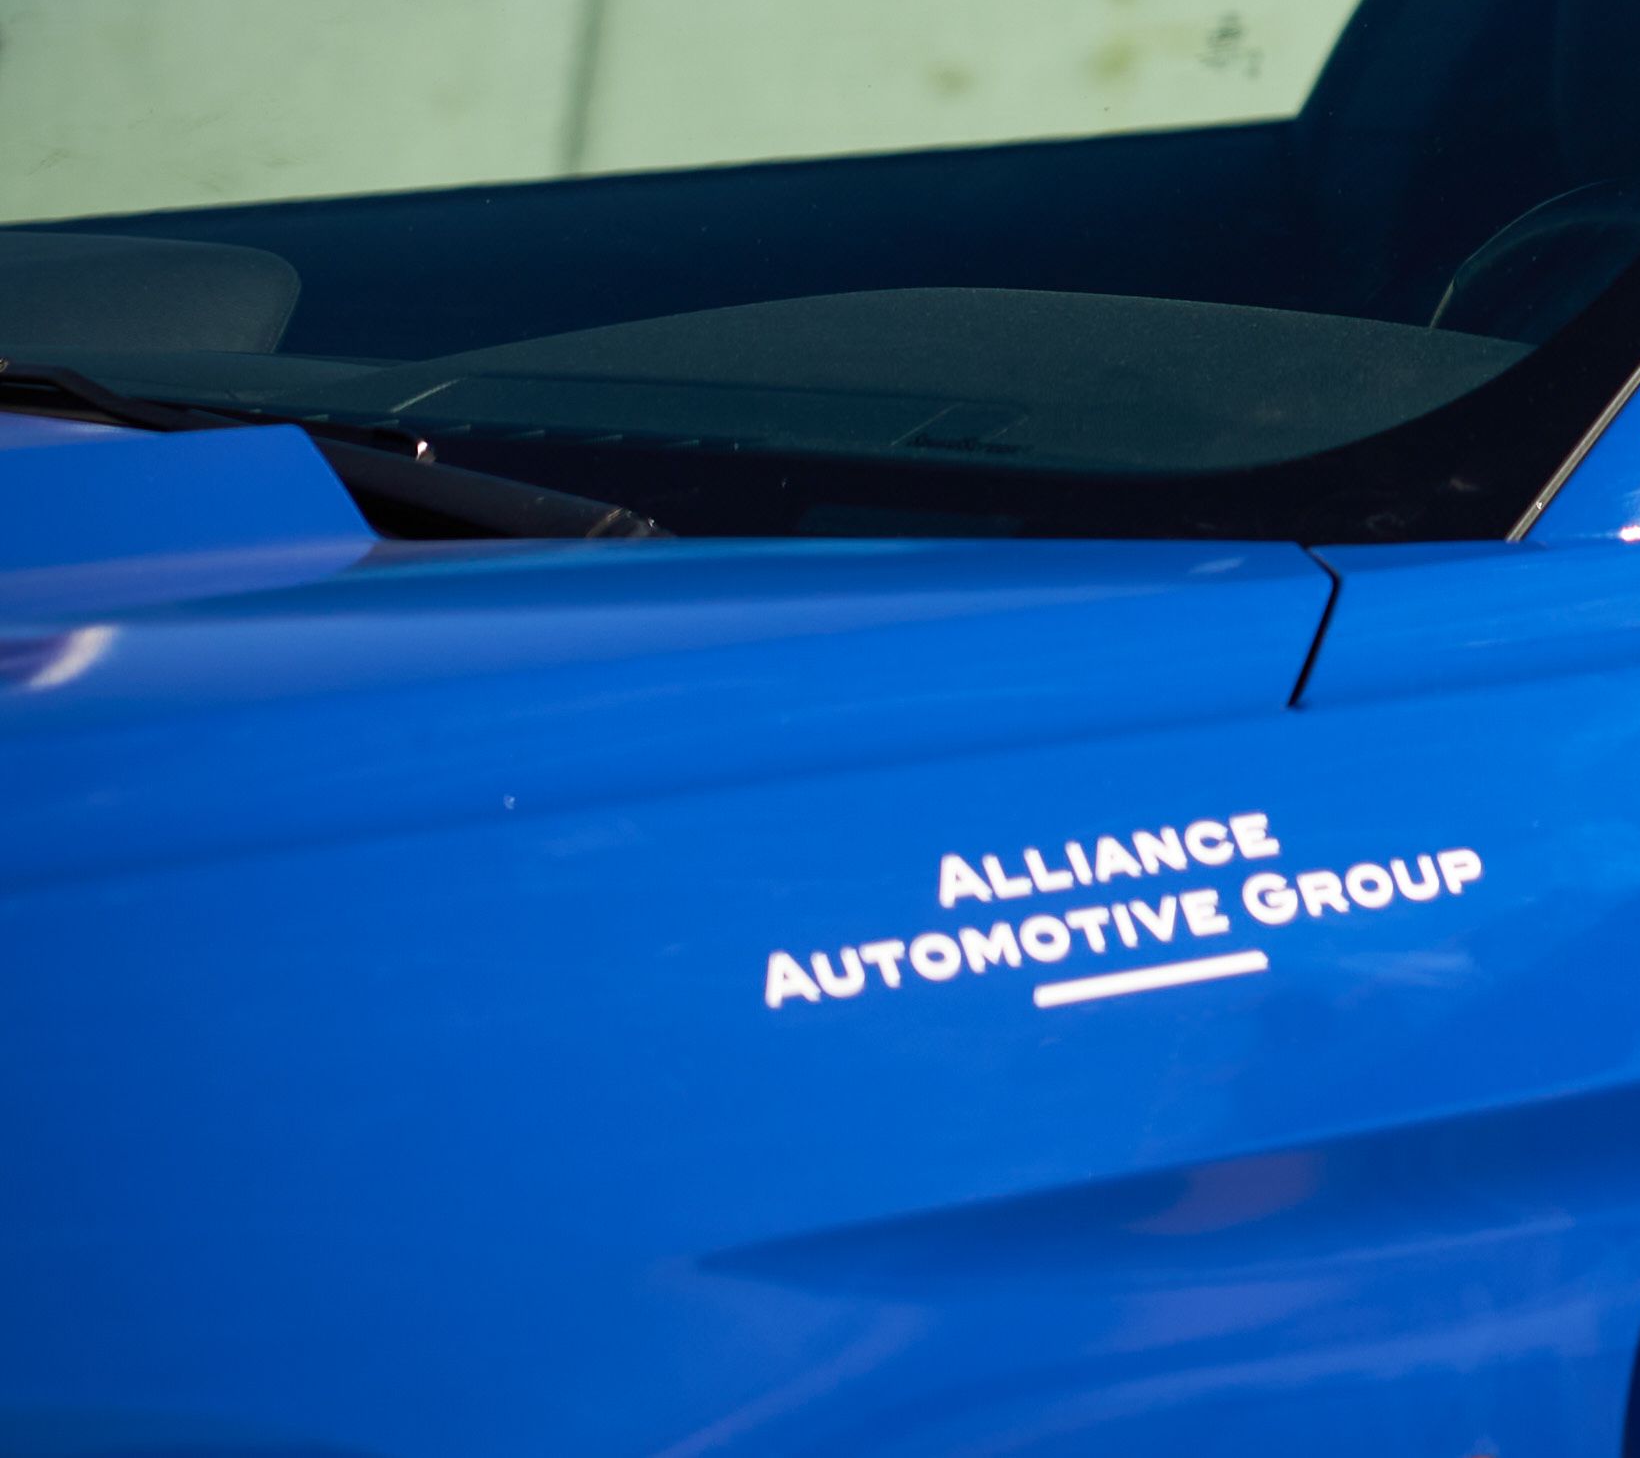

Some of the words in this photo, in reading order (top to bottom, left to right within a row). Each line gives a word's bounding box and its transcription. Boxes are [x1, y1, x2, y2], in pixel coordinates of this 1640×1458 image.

[939, 812, 1281, 908] ALLIANCE
[764, 887, 1231, 1008] AUTOMOTIVE
[1241, 848, 1483, 926] GROUP
